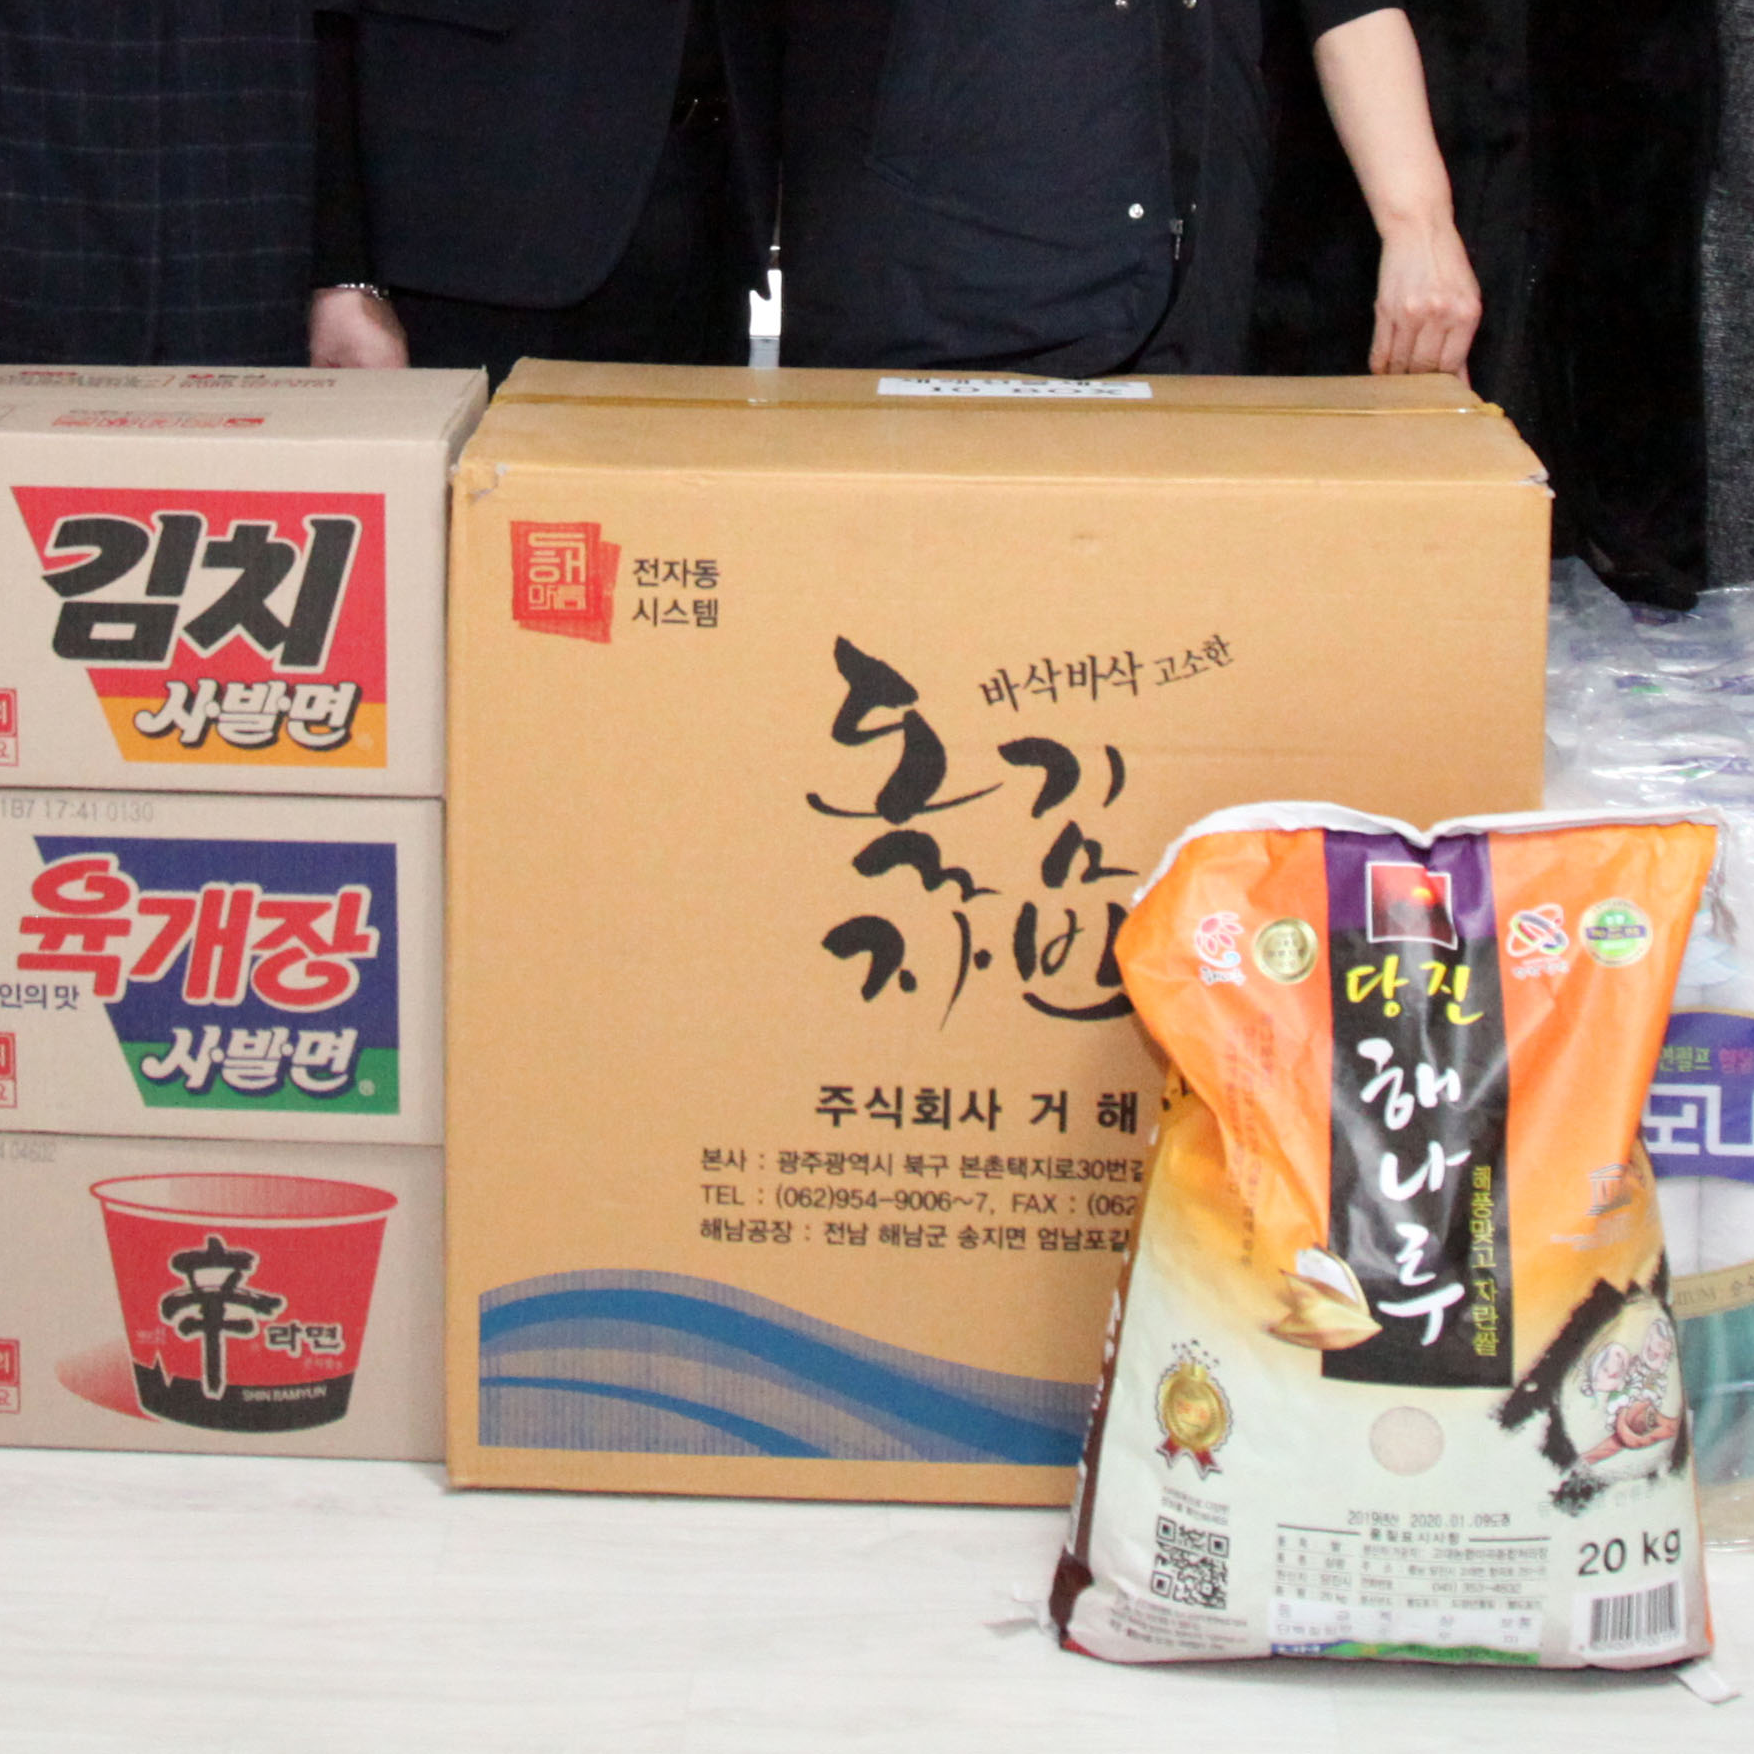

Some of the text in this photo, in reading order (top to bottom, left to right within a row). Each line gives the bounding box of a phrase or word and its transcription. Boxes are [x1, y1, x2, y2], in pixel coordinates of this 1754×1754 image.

[41, 512, 359, 667] 김치
[632, 557, 721, 589] 전자동
[632, 597, 719, 628] 시스템
[978, 633, 1235, 714] 바삭바삭 고소한
[134, 678, 363, 752] 사발면
[16, 856, 372, 1014] 육개장
[53, 982, 80, 1011] 맛
[1347, 954, 1484, 1025] 당진
[142, 1026, 359, 1093] 사발면
[815, 1085, 1002, 1131] 주식회사
[700, 1147, 746, 1173] 본사
[778, 1149, 893, 1177] 광주광역시
[903, 1153, 949, 1178] 북구
[700, 1184, 746, 1207] TEL
[1011, 1191, 1056, 1215] FAX
[1357, 1038, 1472, 1346] 해나루
[700, 1218, 793, 1244] 해남공장
[825, 1222, 868, 1246] 전남
[878, 1224, 946, 1249] 해남군
[957, 1226, 1026, 1251] 송지면
[161, 1235, 286, 1400] 辛
[265, 1320, 345, 1358] 라면
[1578, 1537, 1627, 1577] 20
[1641, 1527, 1683, 1568] kg
